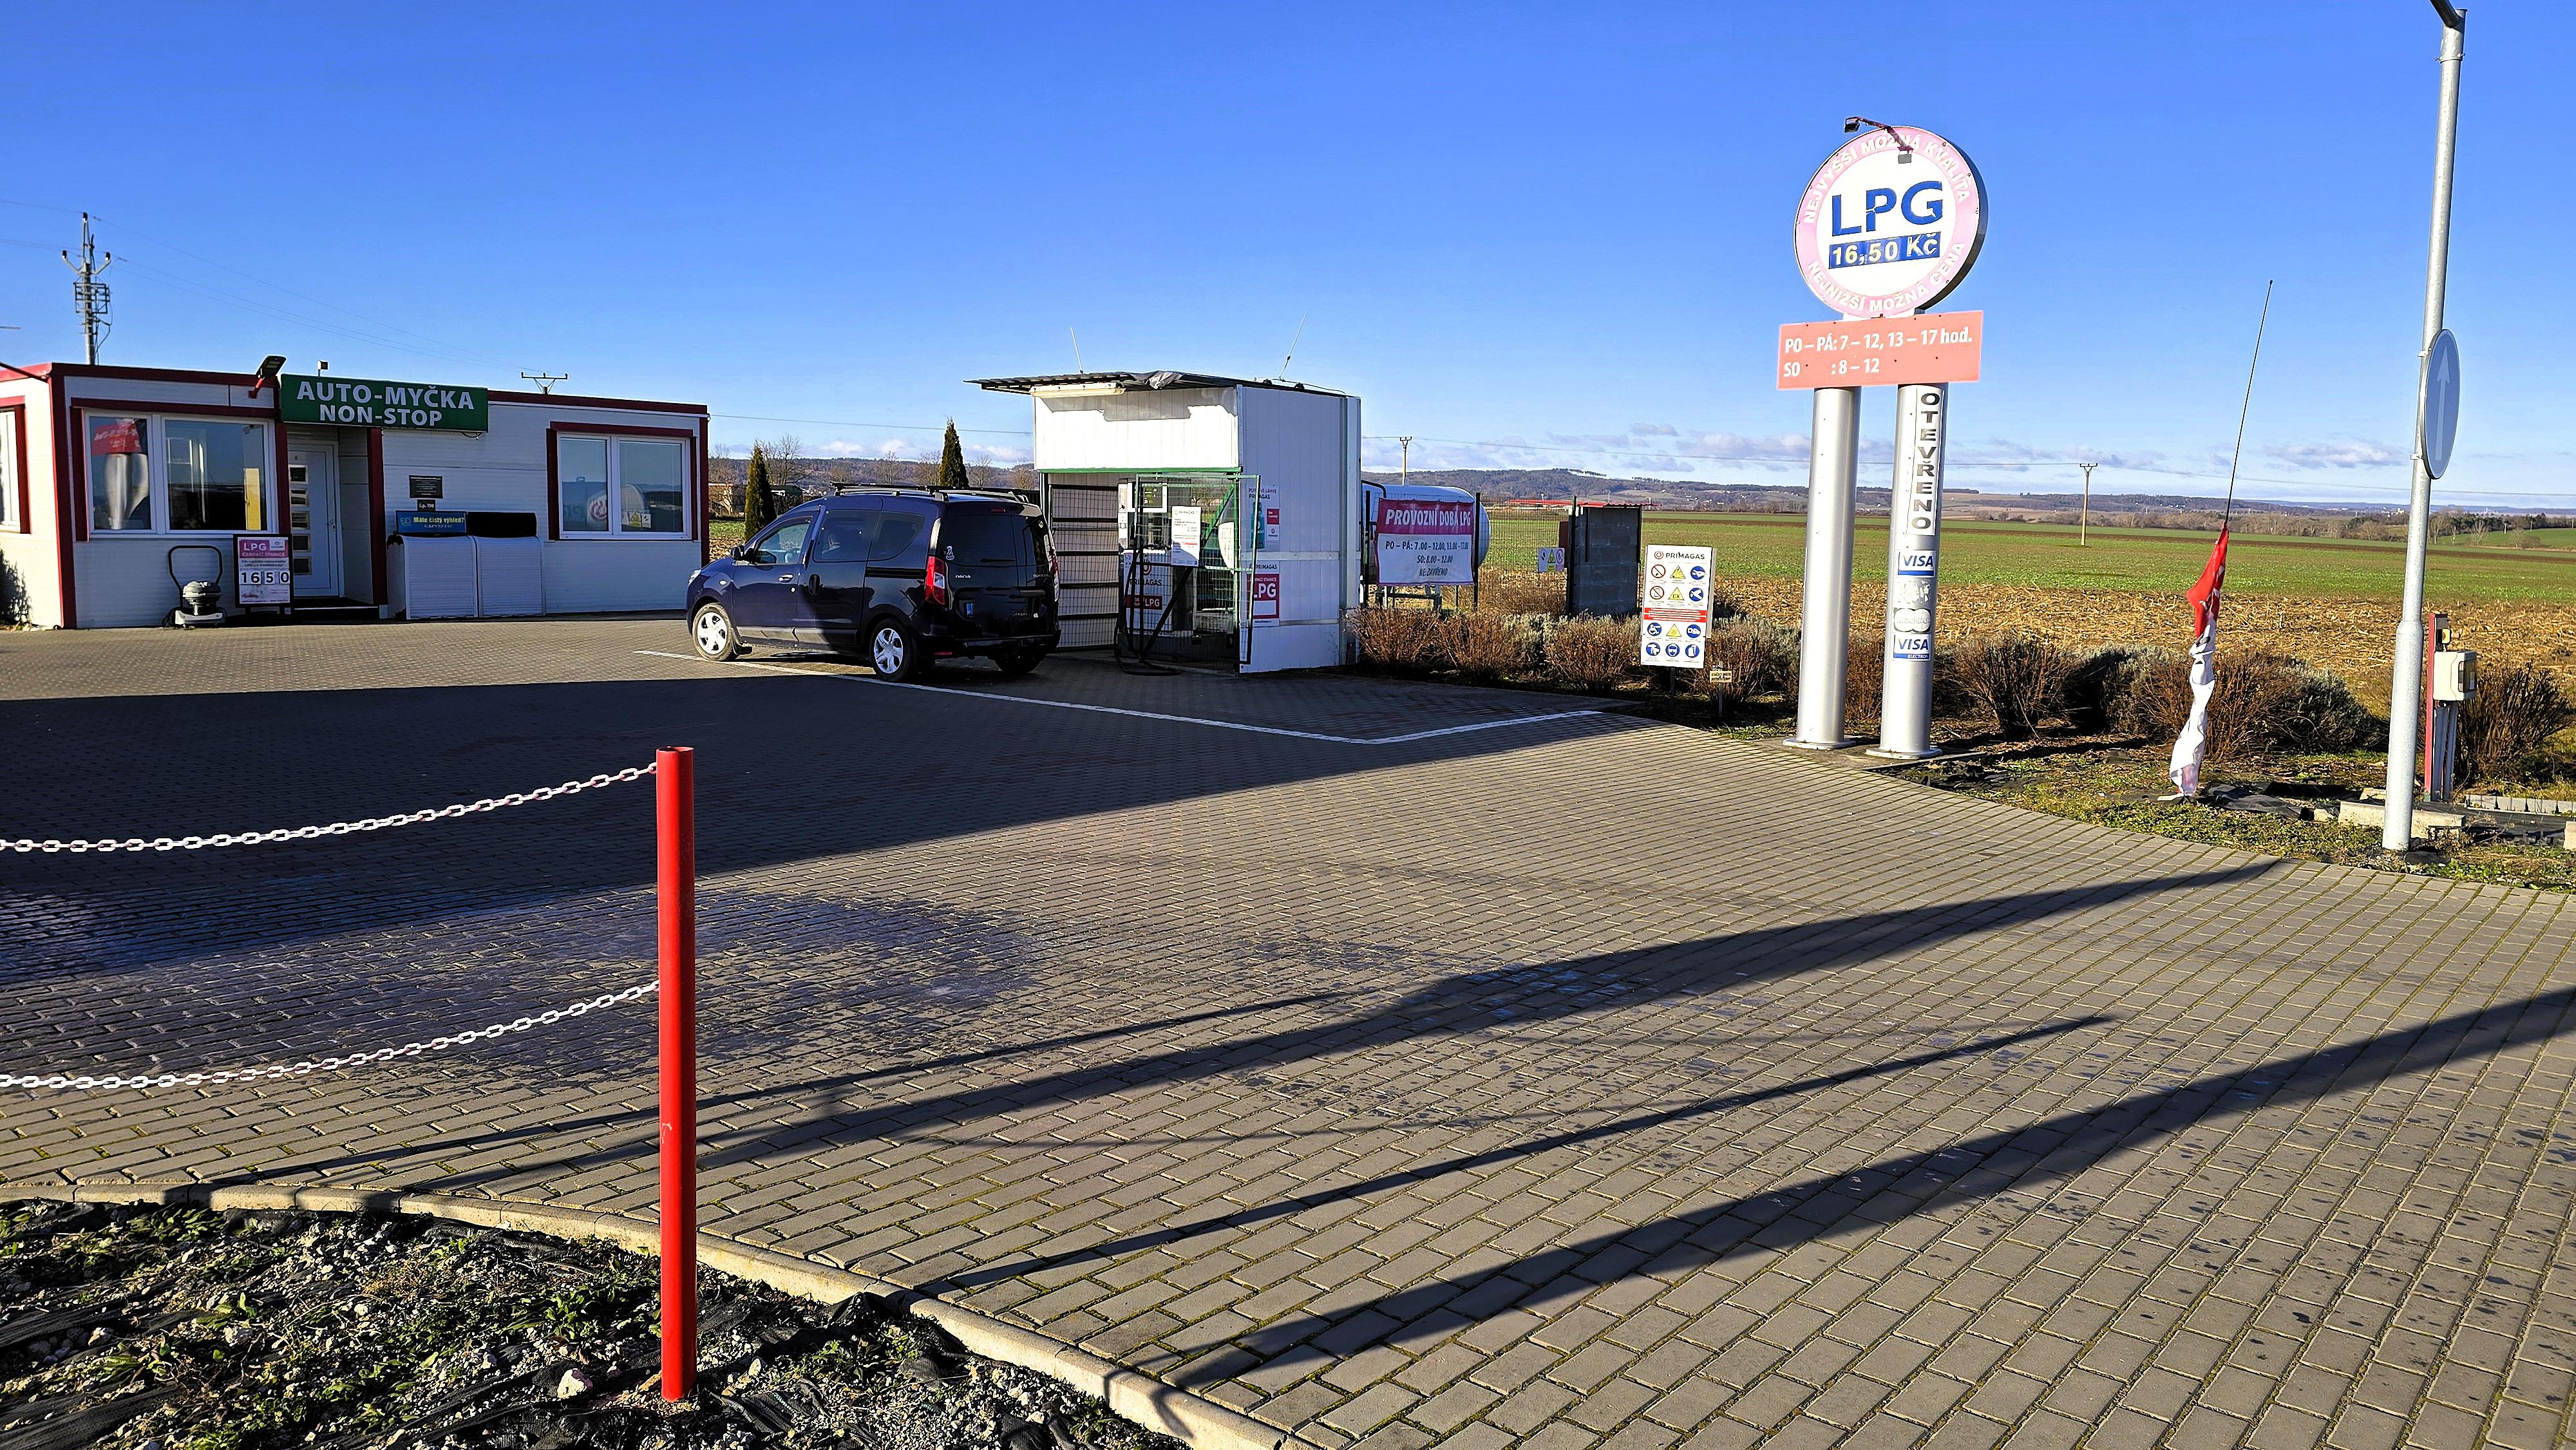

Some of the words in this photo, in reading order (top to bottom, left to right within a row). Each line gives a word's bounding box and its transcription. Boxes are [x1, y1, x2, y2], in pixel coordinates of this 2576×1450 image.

[1804, 144, 1858, 223] NEJVYŠŠÍ
[1923, 140, 1970, 203] KVALITA
[1832, 180, 1944, 237] LPG
[1833, 241, 1899, 265] 16,50
[1808, 260, 1866, 311] NEJNIŽŠÍ
[1869, 283, 1931, 312] MOŽNÁ
[1930, 243, 1966, 287] CENA
[1785, 337, 1803, 353] PO
[1817, 332, 1837, 352] PÁ:
[1840, 335, 1849, 350] 7
[1864, 333, 1884, 350] 12,
[1888, 332, 1904, 347] 13
[1921, 329, 1938, 345] 17
[1940, 326, 1973, 344] hod.
[1783, 361, 1801, 377] SO
[1864, 357, 1880, 373] 12
[296, 381, 475, 410] AUTO-MYČKA
[319, 404, 442, 426] NON-STOP
[1911, 393, 1940, 529] OTEVŘENO
[1385, 508, 1437, 525] PROVOZNÍ
[1460, 511, 1471, 526] LPG
[243, 542, 267, 551] LPG
[1385, 540, 1395, 550] PO
[1402, 540, 1413, 550] PÁ:
[1415, 541, 1428, 550] 7.00
[1903, 555, 1933, 567] VISA
[1145, 598, 1160, 607] LPG
[1898, 639, 1929, 650] VISA
